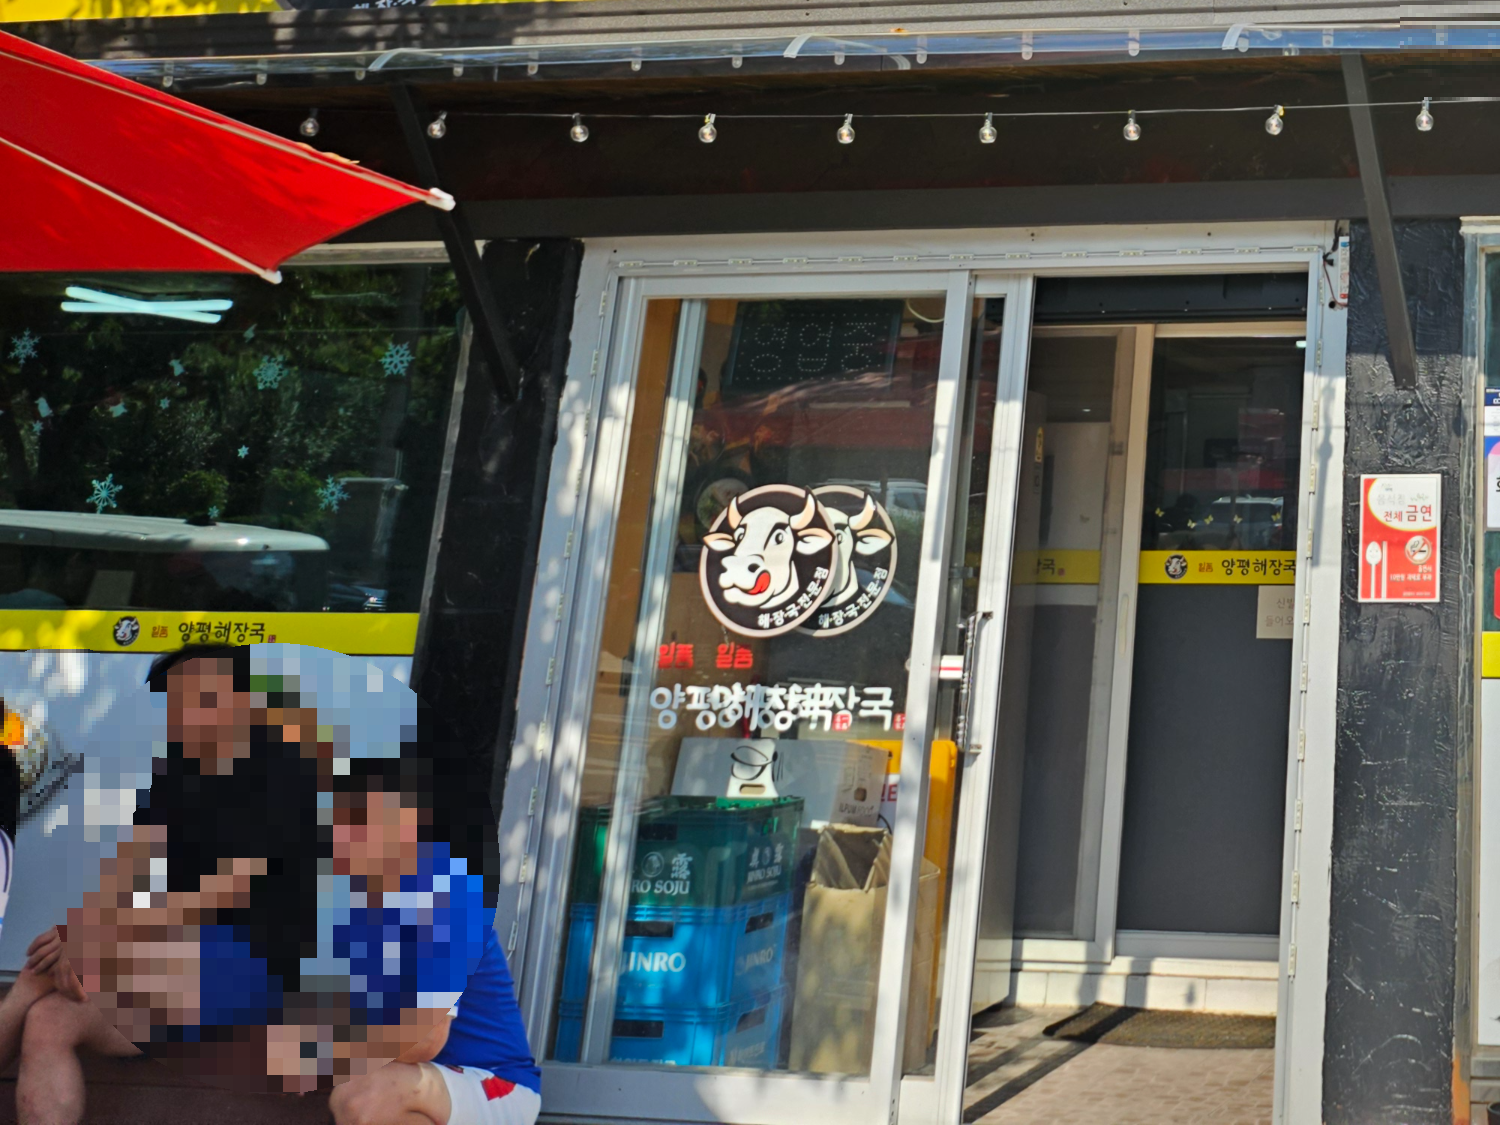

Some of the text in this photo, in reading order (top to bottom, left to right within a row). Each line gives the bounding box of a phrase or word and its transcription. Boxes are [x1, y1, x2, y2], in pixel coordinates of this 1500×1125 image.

[750, 321, 877, 372] 영업중
[1383, 504, 1432, 522] 전체 금연
[1222, 558, 1296, 576] 양평해장국
[178, 621, 265, 643] 양평해장국
[654, 879, 690, 895] SOJU
[745, 948, 773, 971] JINRO
